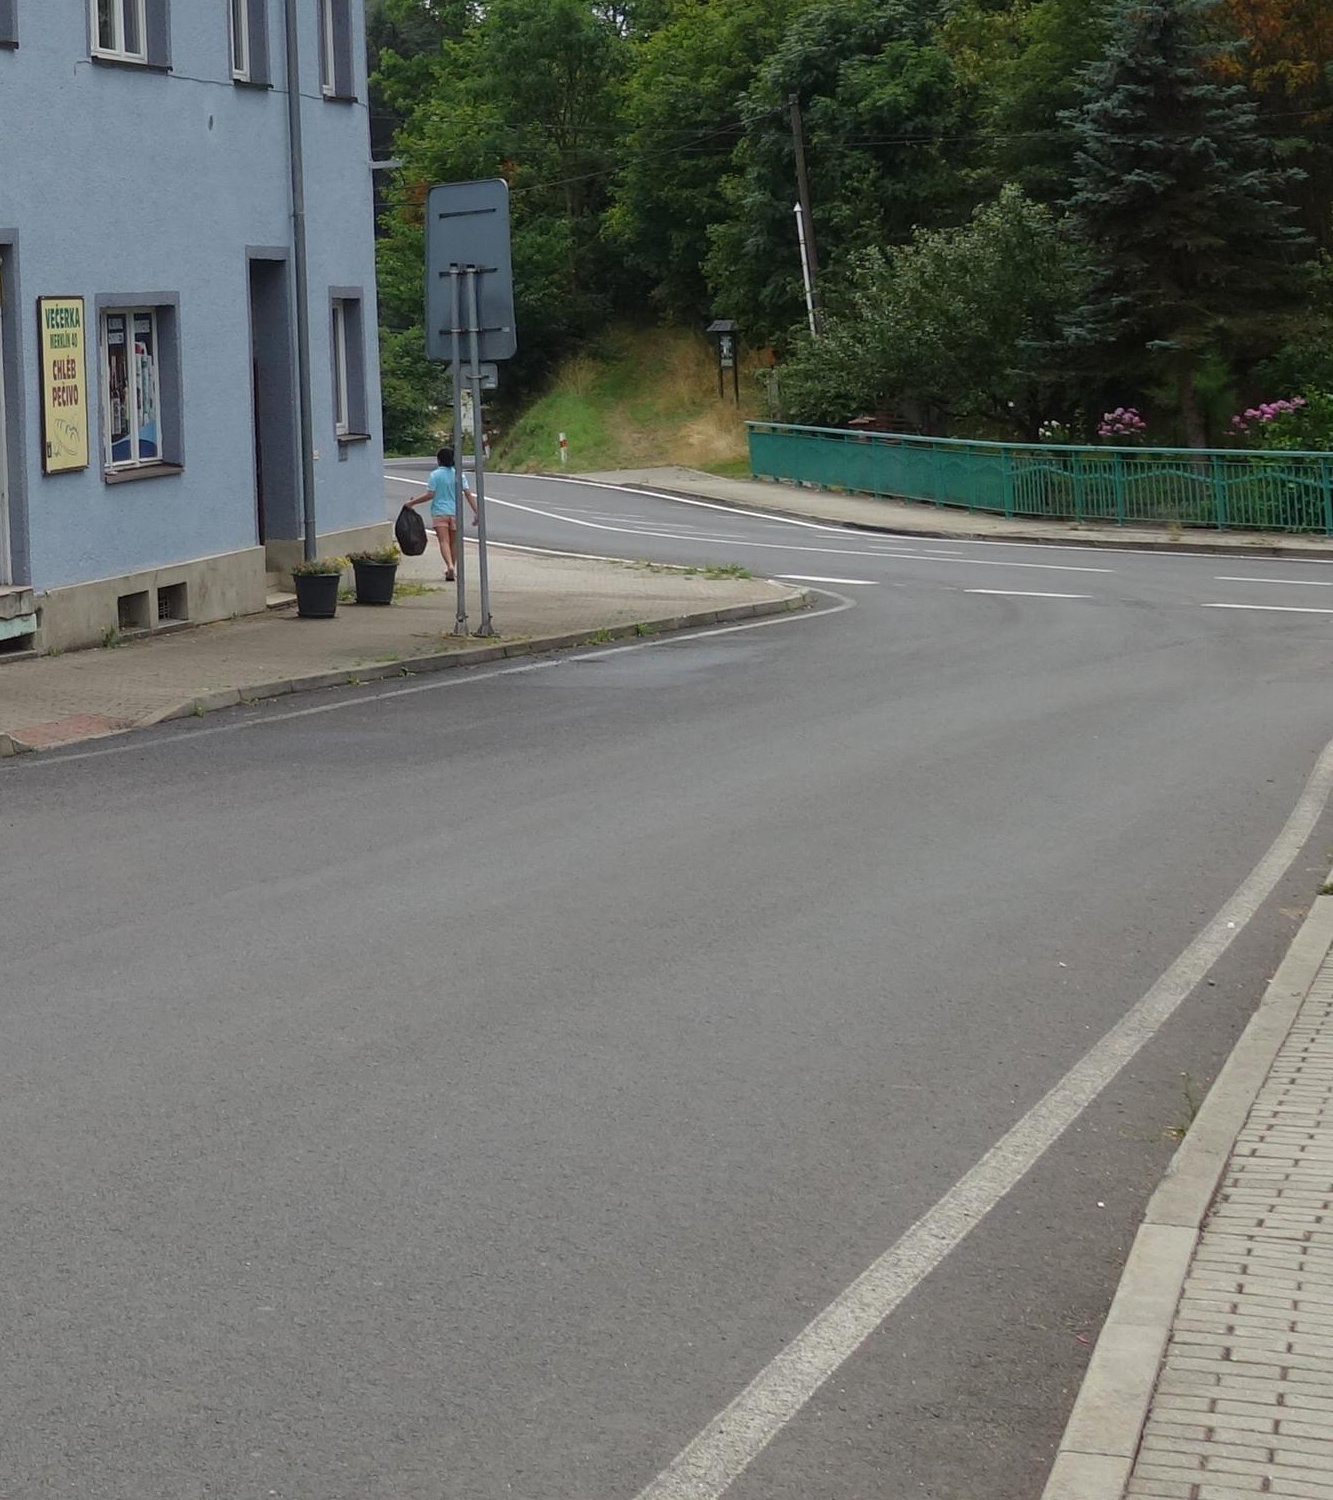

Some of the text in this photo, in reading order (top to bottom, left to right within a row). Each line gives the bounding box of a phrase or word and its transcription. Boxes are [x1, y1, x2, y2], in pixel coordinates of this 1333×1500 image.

[45, 304, 80, 329] VEČERKA
[53, 355, 76, 381] CHLÉB
[52, 381, 79, 408] PEČIVO
